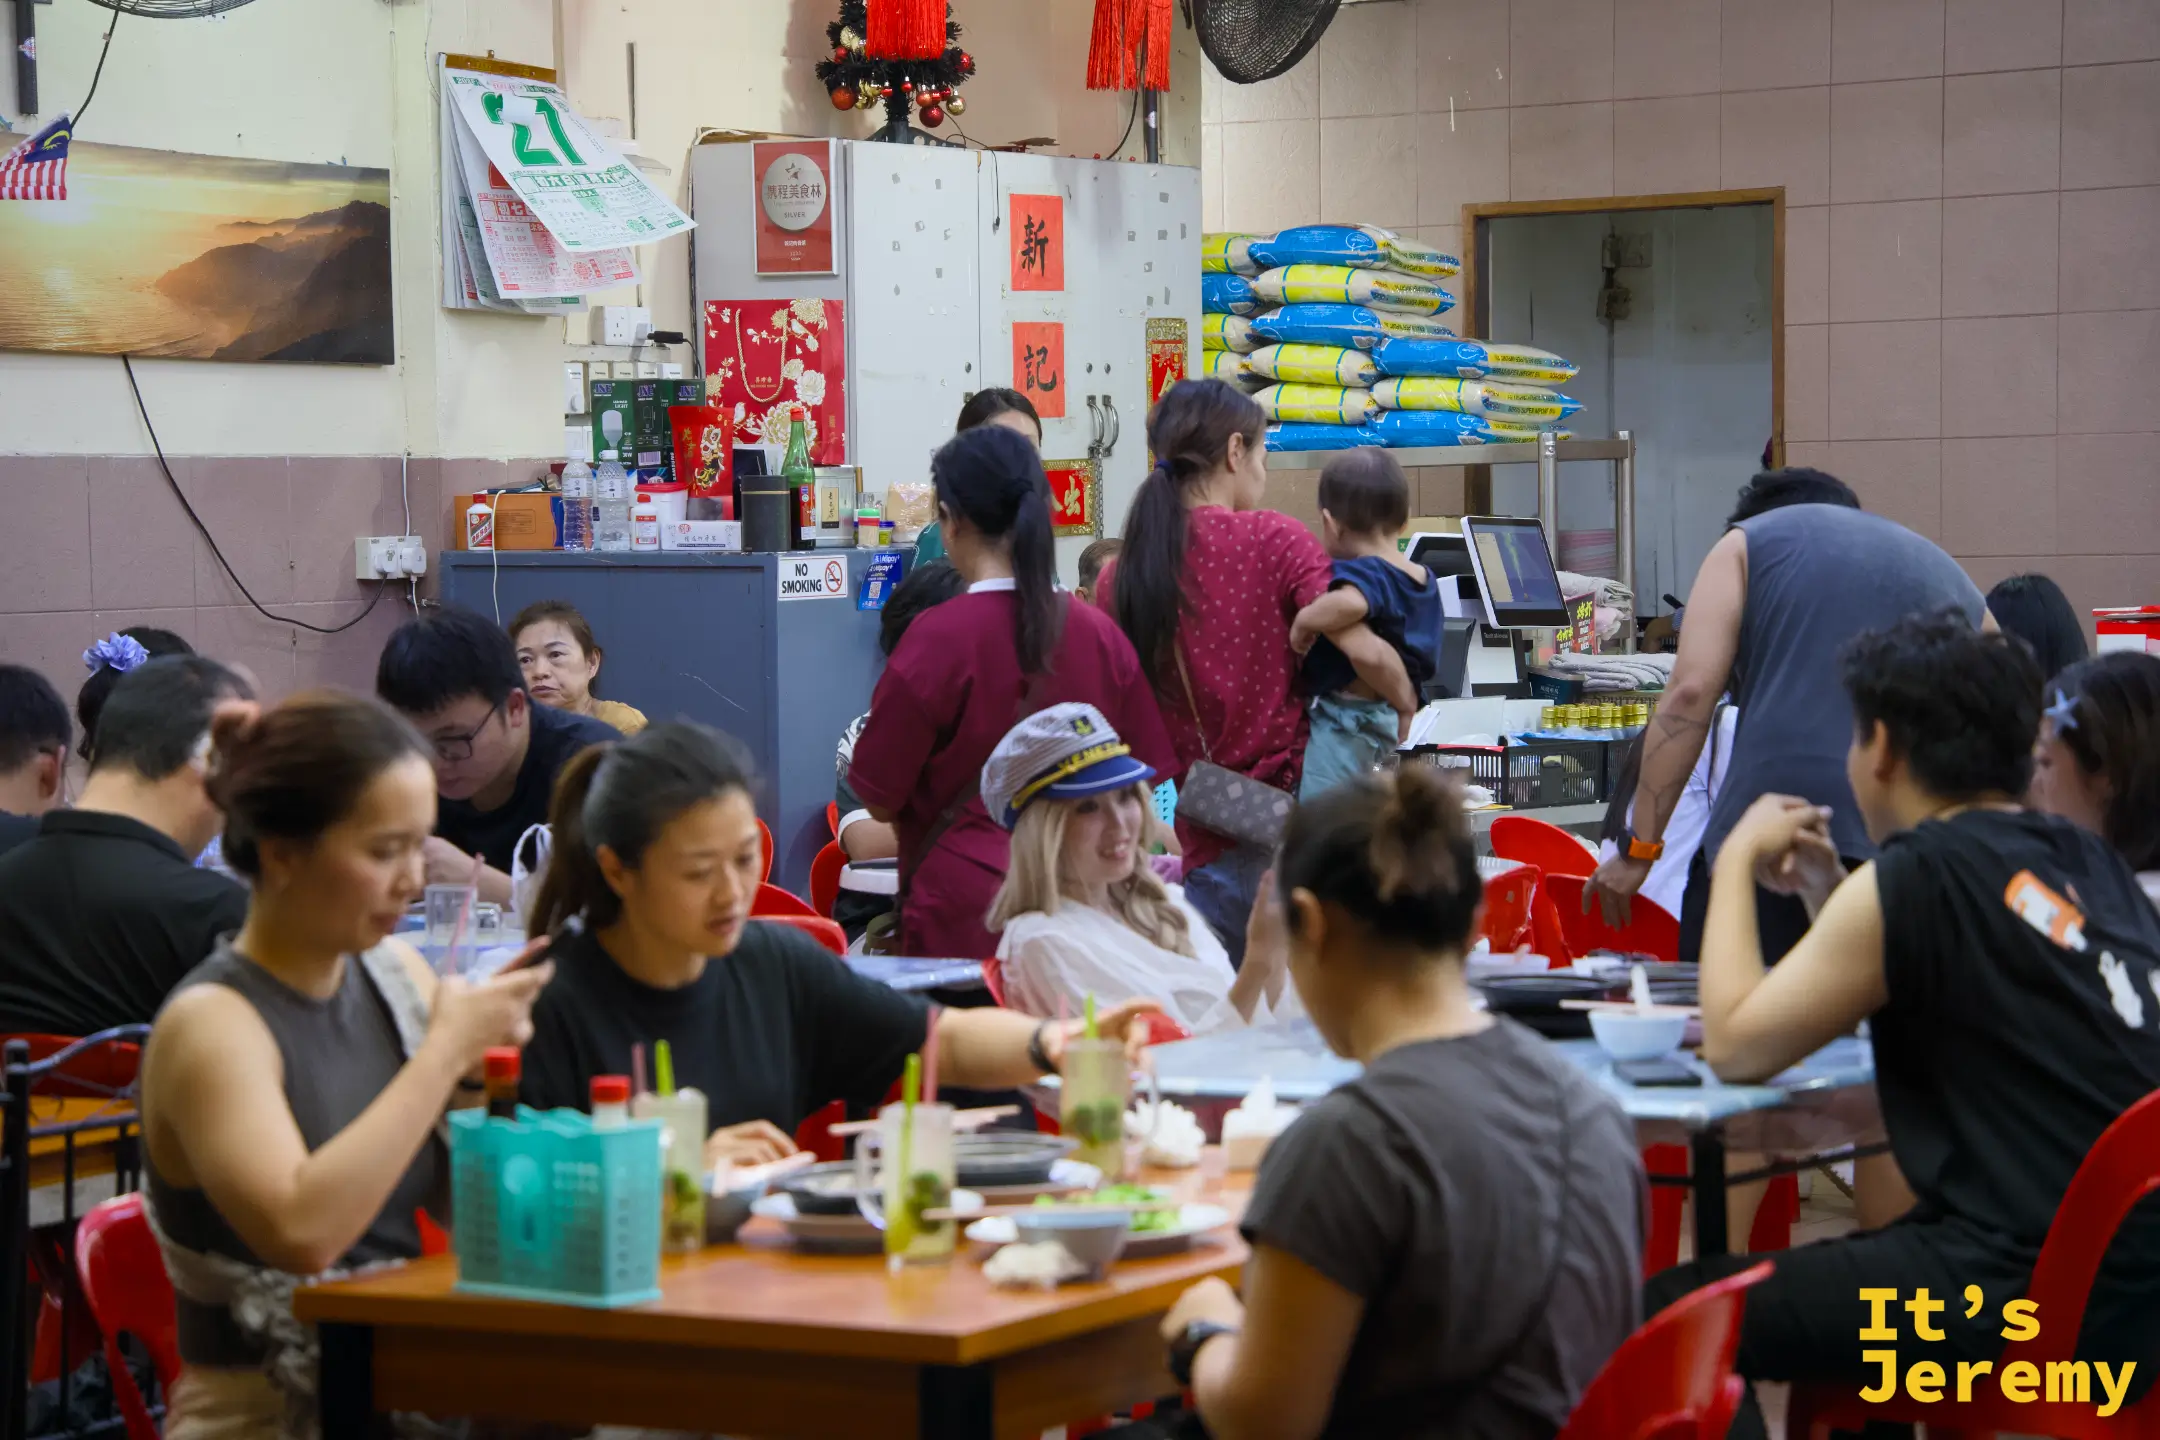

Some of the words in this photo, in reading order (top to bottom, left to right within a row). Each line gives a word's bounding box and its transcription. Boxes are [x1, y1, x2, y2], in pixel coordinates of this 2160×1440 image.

[1021, 215, 1049, 277] 新
[1024, 345, 1056, 393] 記
[795, 563, 808, 577] NO
[782, 579, 822, 593] SMOKING
